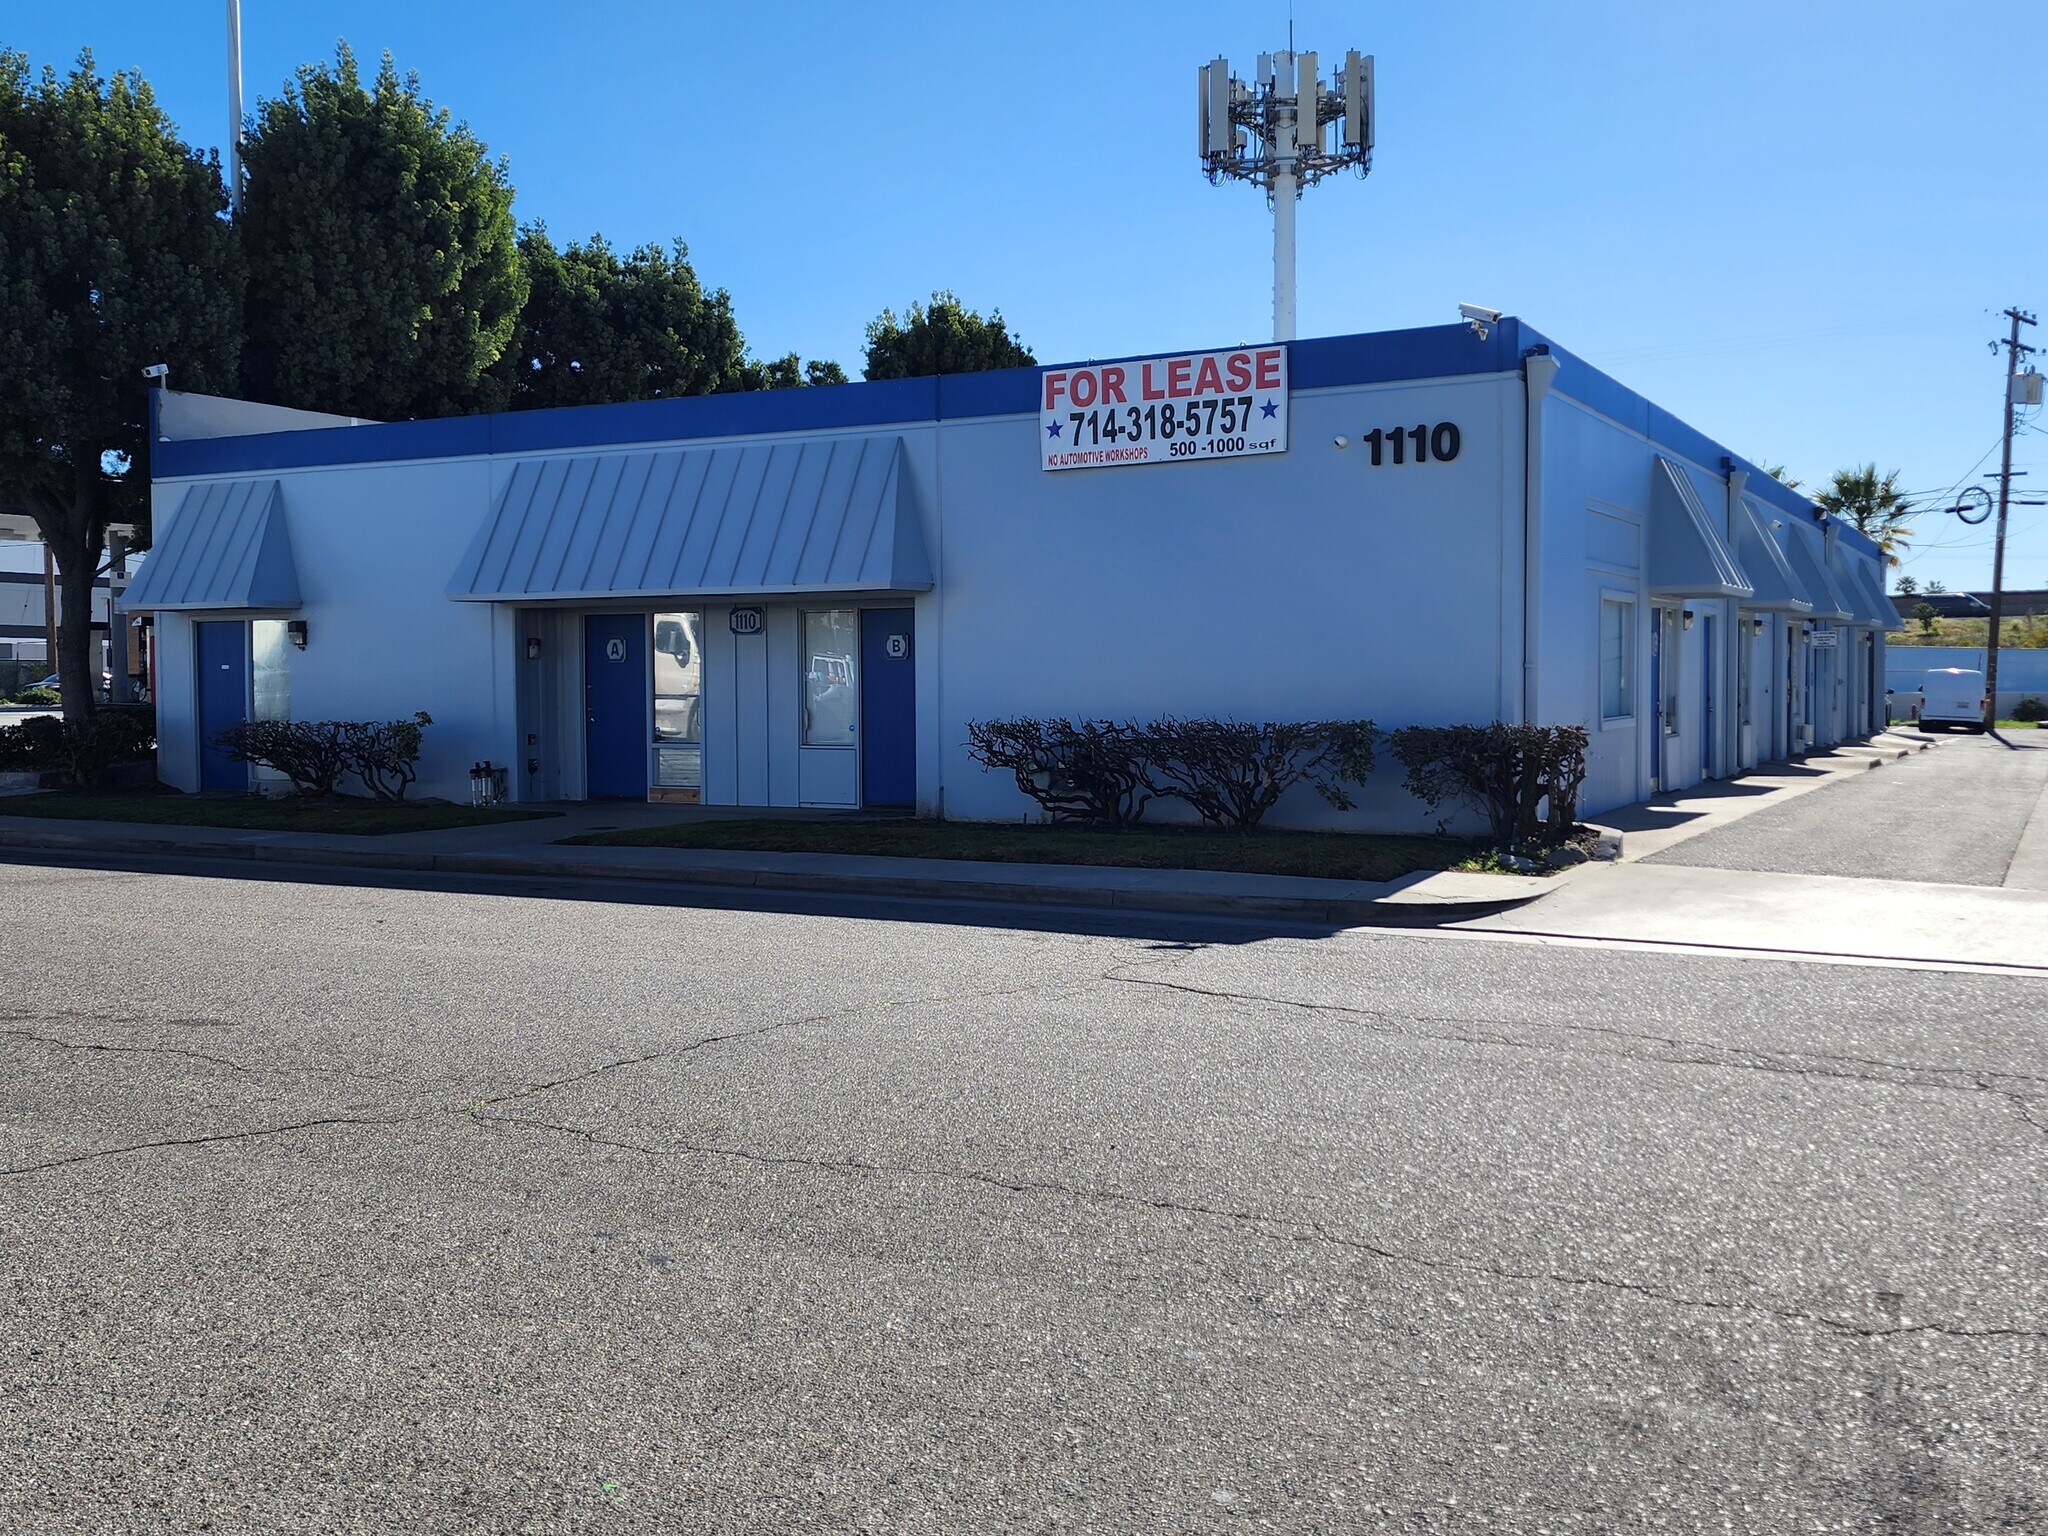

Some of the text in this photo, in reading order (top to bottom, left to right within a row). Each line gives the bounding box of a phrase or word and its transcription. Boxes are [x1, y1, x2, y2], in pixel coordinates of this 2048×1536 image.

[1045, 349, 1281, 410] FOR LEASE
[1069, 396, 1253, 447] 714-318-5757
[1248, 438, 1277, 451] sqf
[1363, 421, 1461, 466] 1110
[1048, 446, 1148, 467] NO AUTOMOTIVE WORKSHOPS
[734, 610, 757, 633] 1110
[610, 642, 620, 656] A
[892, 639, 901, 653] B
